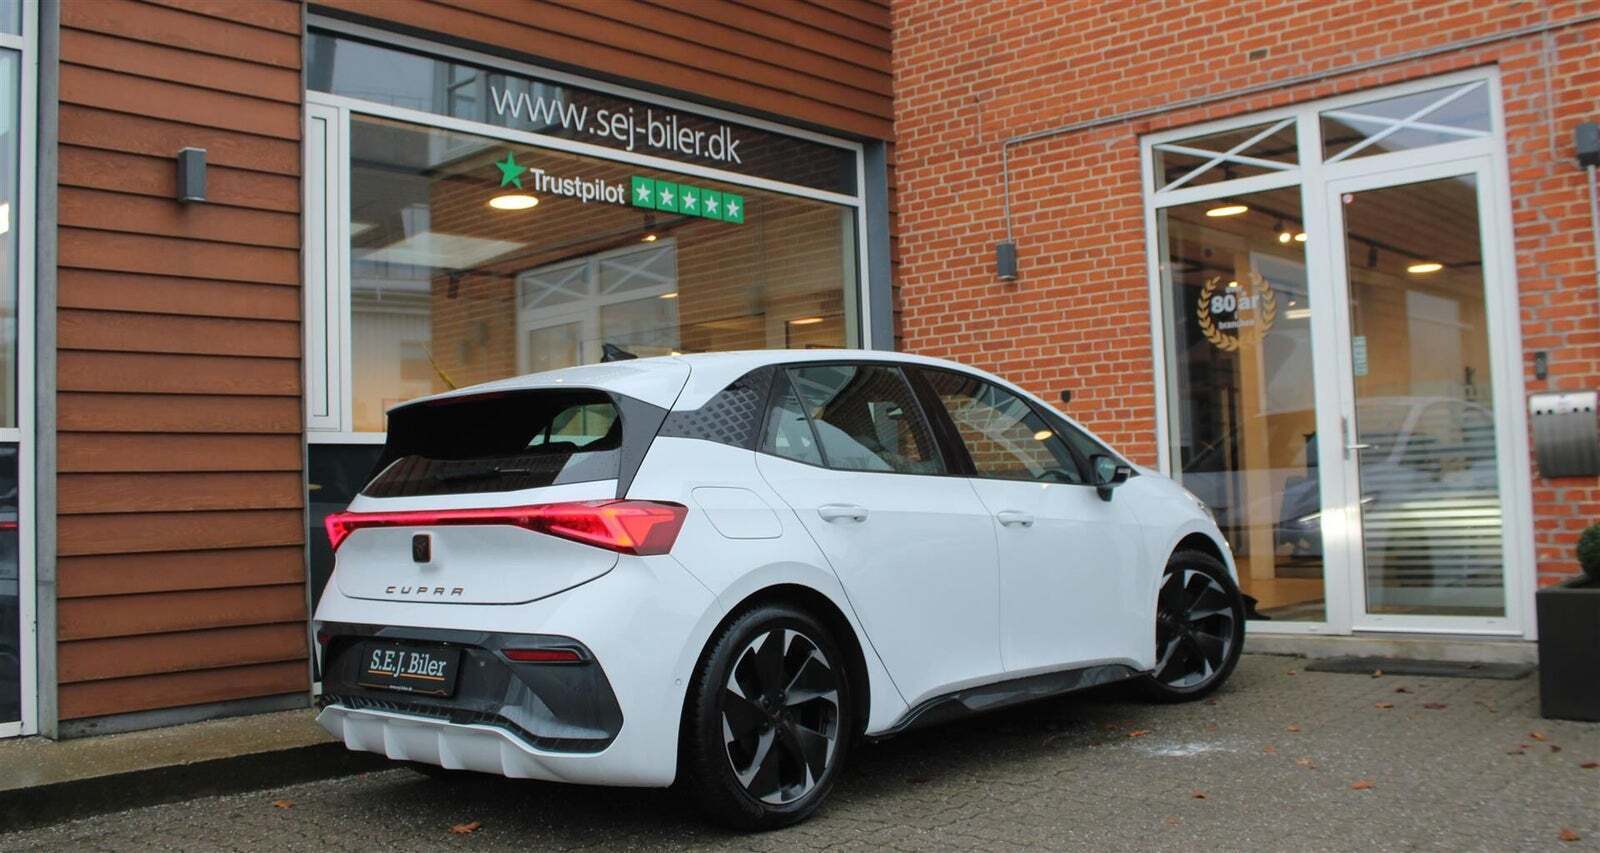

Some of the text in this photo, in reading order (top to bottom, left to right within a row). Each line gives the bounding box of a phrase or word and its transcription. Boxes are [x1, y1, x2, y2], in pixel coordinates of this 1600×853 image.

[491, 86, 742, 164] www.sej-biler.dk
[530, 168, 625, 204] Trustpilot
[1211, 294, 1236, 314] 80
[385, 586, 464, 596] CUPRA
[370, 649, 447, 678] S.E.J. Biler
